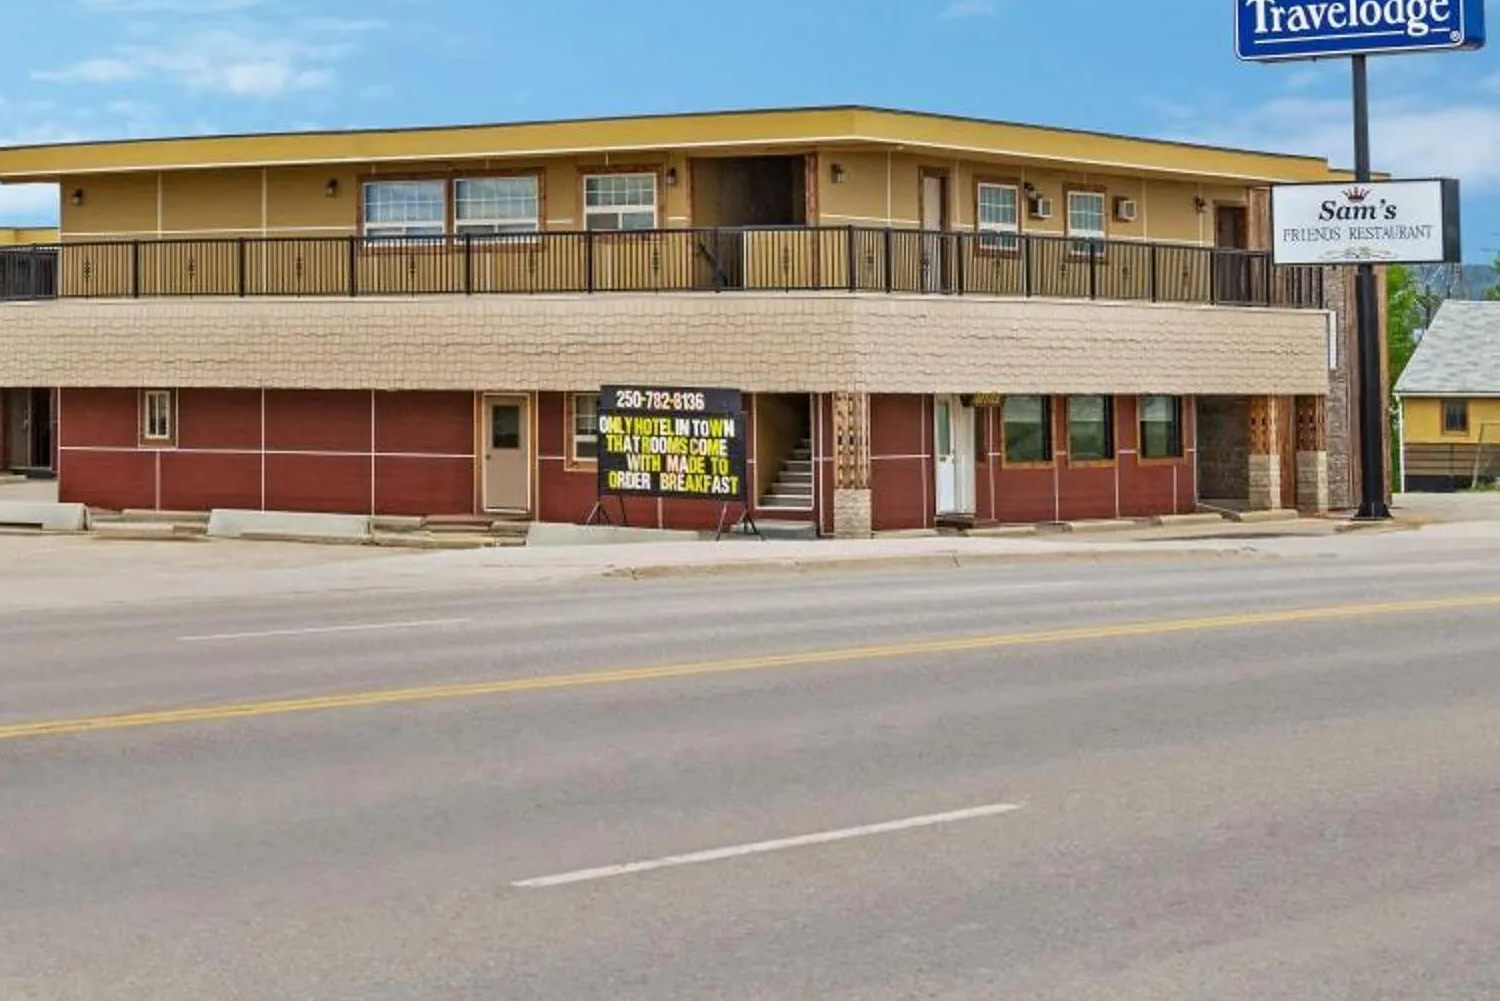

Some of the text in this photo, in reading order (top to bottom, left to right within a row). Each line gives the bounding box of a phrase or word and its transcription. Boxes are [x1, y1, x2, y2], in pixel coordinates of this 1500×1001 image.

[1318, 199, 1397, 221] Sam's
[1283, 225, 1433, 242] FRIENDS RESTAURANT
[616, 390, 705, 410] 250-782-8136
[600, 416, 735, 437] ONLY HOTEL IN TOWN
[606, 435, 728, 456] THAT ROOMS COME
[627, 453, 729, 475] WITH MADE TO
[609, 471, 738, 494] ORDER BREAKFAST
